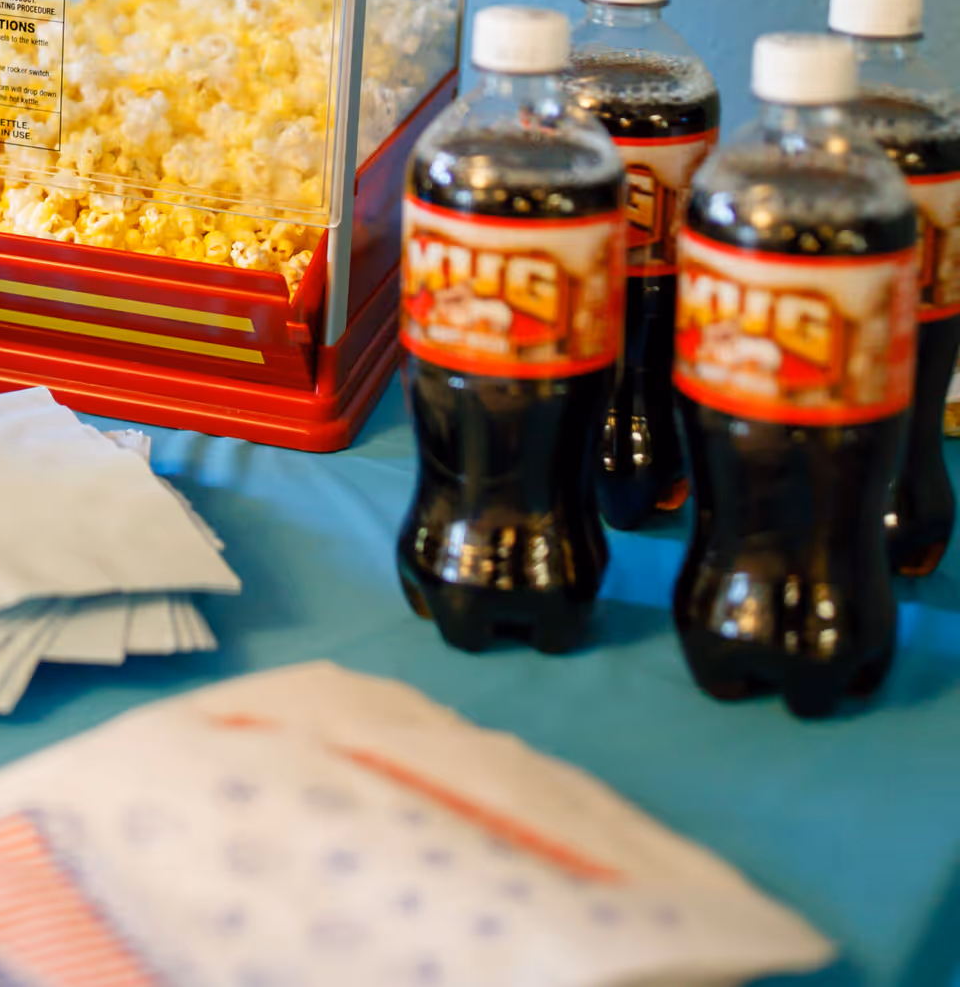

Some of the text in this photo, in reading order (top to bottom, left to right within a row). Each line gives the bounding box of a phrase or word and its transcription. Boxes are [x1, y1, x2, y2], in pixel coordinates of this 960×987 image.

[16, 3, 57, 16] PROCEDURE.
[11, 35, 18, 43] to
[18, 36, 30, 44] the
[30, 37, 49, 46] kettle
[7, 66, 28, 74] rocker
[28, 68, 50, 77] switch
[10, 85, 22, 93] will
[23, 87, 38, 97] drop
[39, 89, 57, 98] down
[8, 95, 20, 103] hot
[0, 129, 10, 137] IN
[11, 130, 33, 141] USE.
[407, 238, 559, 326] MUG
